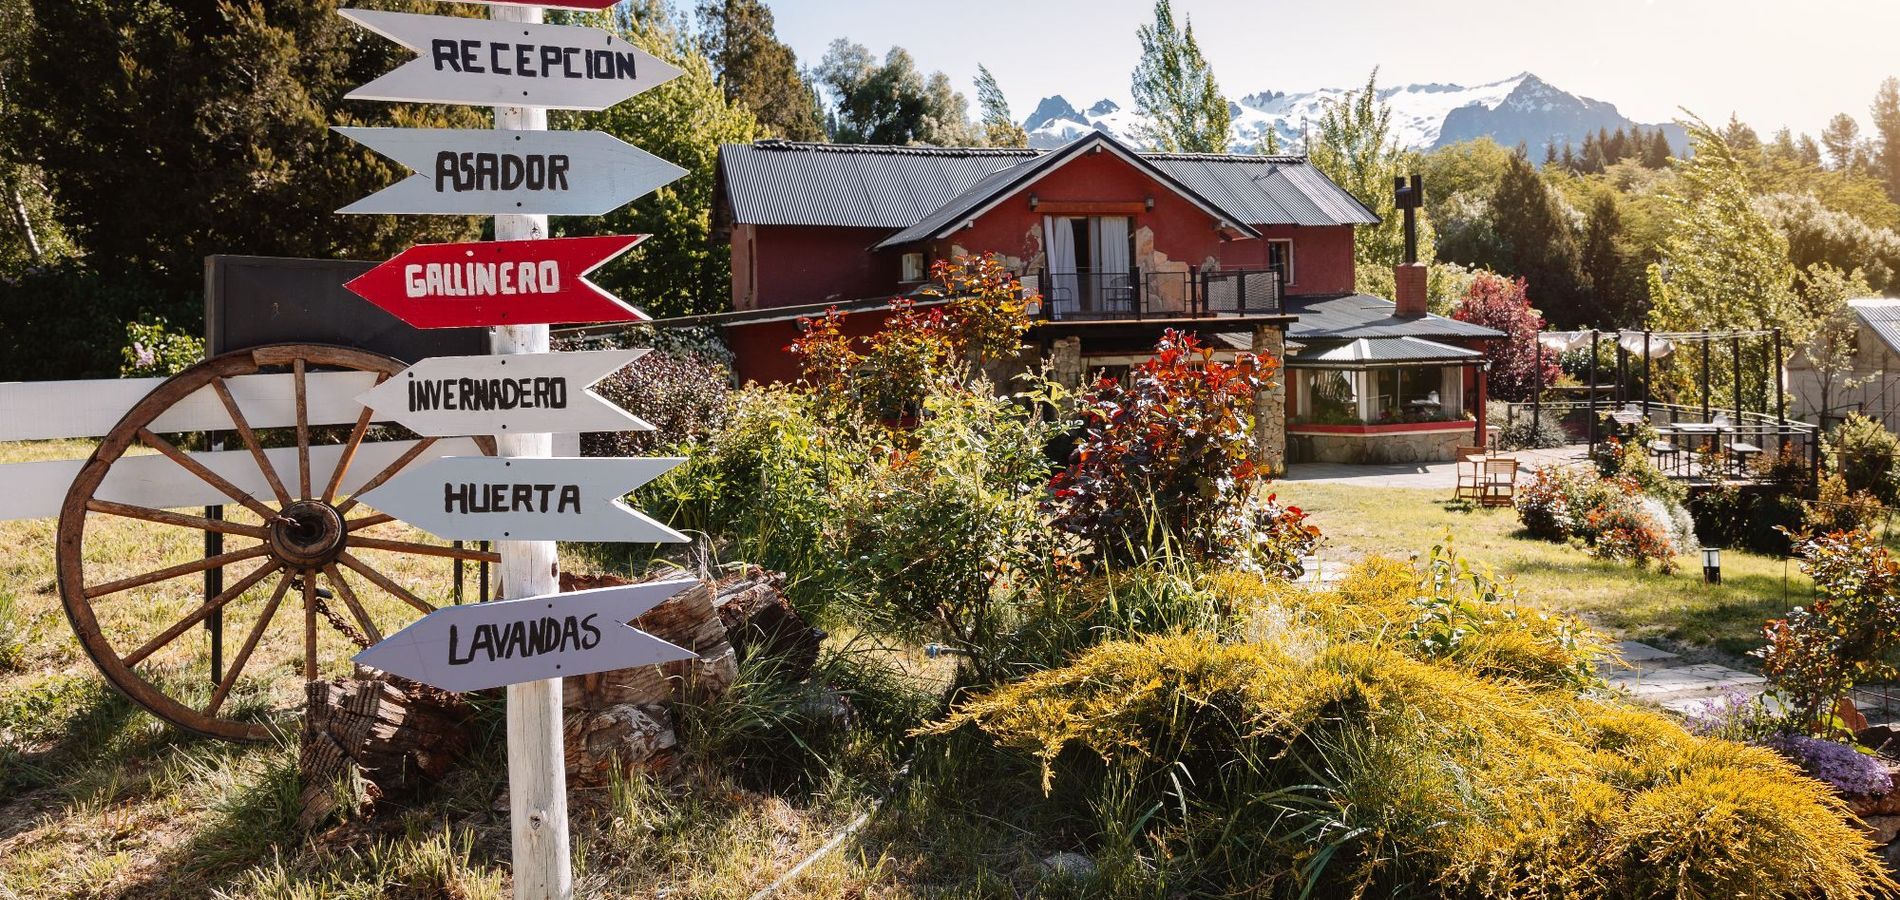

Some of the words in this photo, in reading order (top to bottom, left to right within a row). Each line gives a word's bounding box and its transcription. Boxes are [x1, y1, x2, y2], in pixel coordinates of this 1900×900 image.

[431, 35, 637, 80] RECEPCIÓN
[435, 151, 570, 192] ASADOR
[444, 483, 582, 514] HUERTA
[448, 613, 601, 666] LAVANDAS
